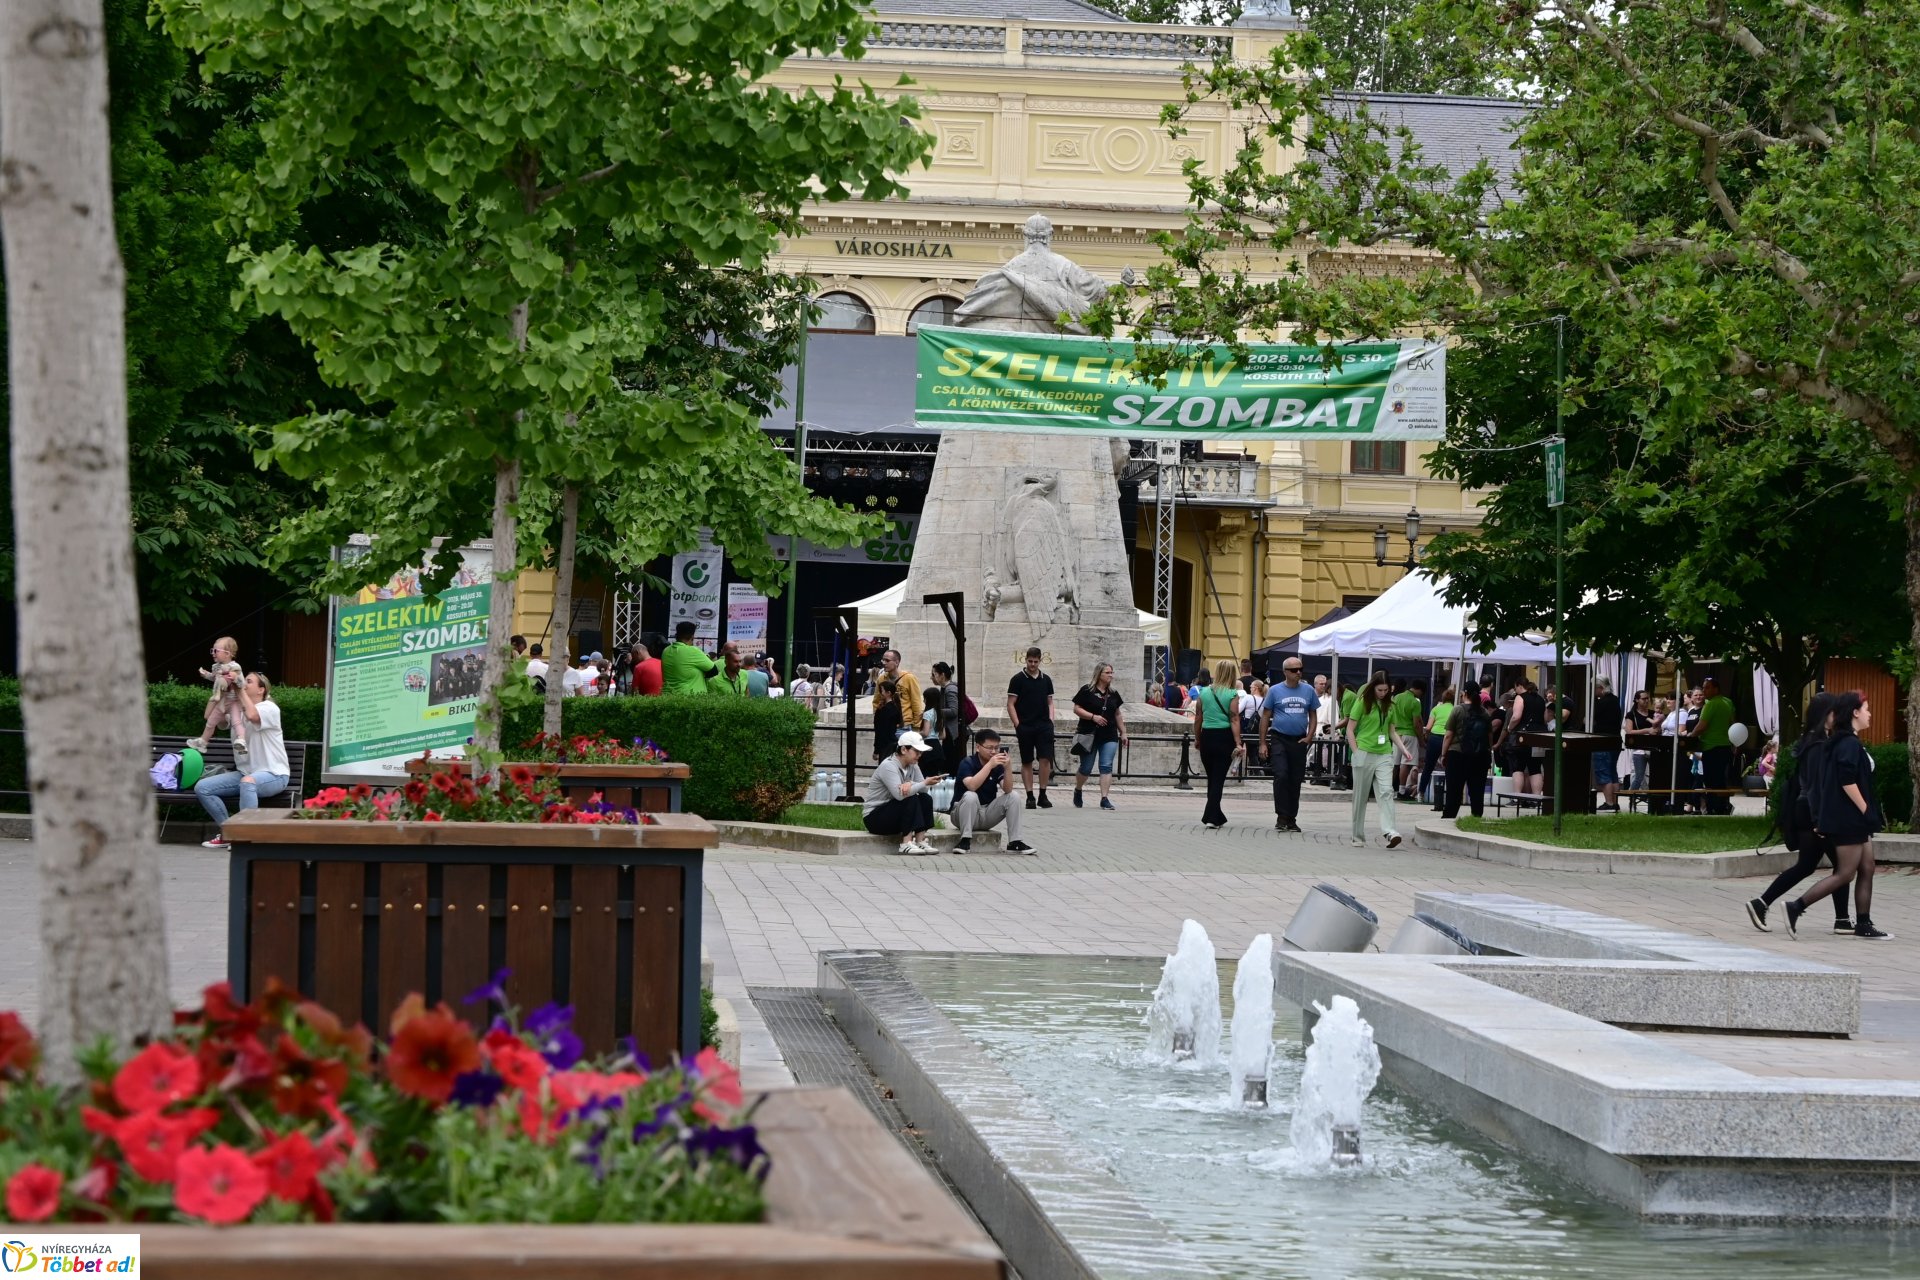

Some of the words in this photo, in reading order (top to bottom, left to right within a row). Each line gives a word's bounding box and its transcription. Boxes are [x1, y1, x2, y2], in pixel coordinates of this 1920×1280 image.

[835, 237, 953, 258] VÁROSHÁZA
[1361, 353, 1386, 363] 30.
[1407, 358, 1434, 371] EAK
[937, 347, 1238, 388] SZELEKÍV
[1244, 373, 1303, 381] KOSSUTH
[932, 385, 991, 396] CSALÁDI
[995, 387, 1104, 402] VETÉLKEDŐNAP
[948, 398, 957, 407] A
[961, 398, 1101, 414] KÖRNYEZETÜNKÉRT
[1107, 394, 1376, 428] SZOMBAT
[673, 591, 718, 604] otpbank
[340, 600, 445, 637] SZELEKTÍV
[1012, 650, 1052, 664] 188
